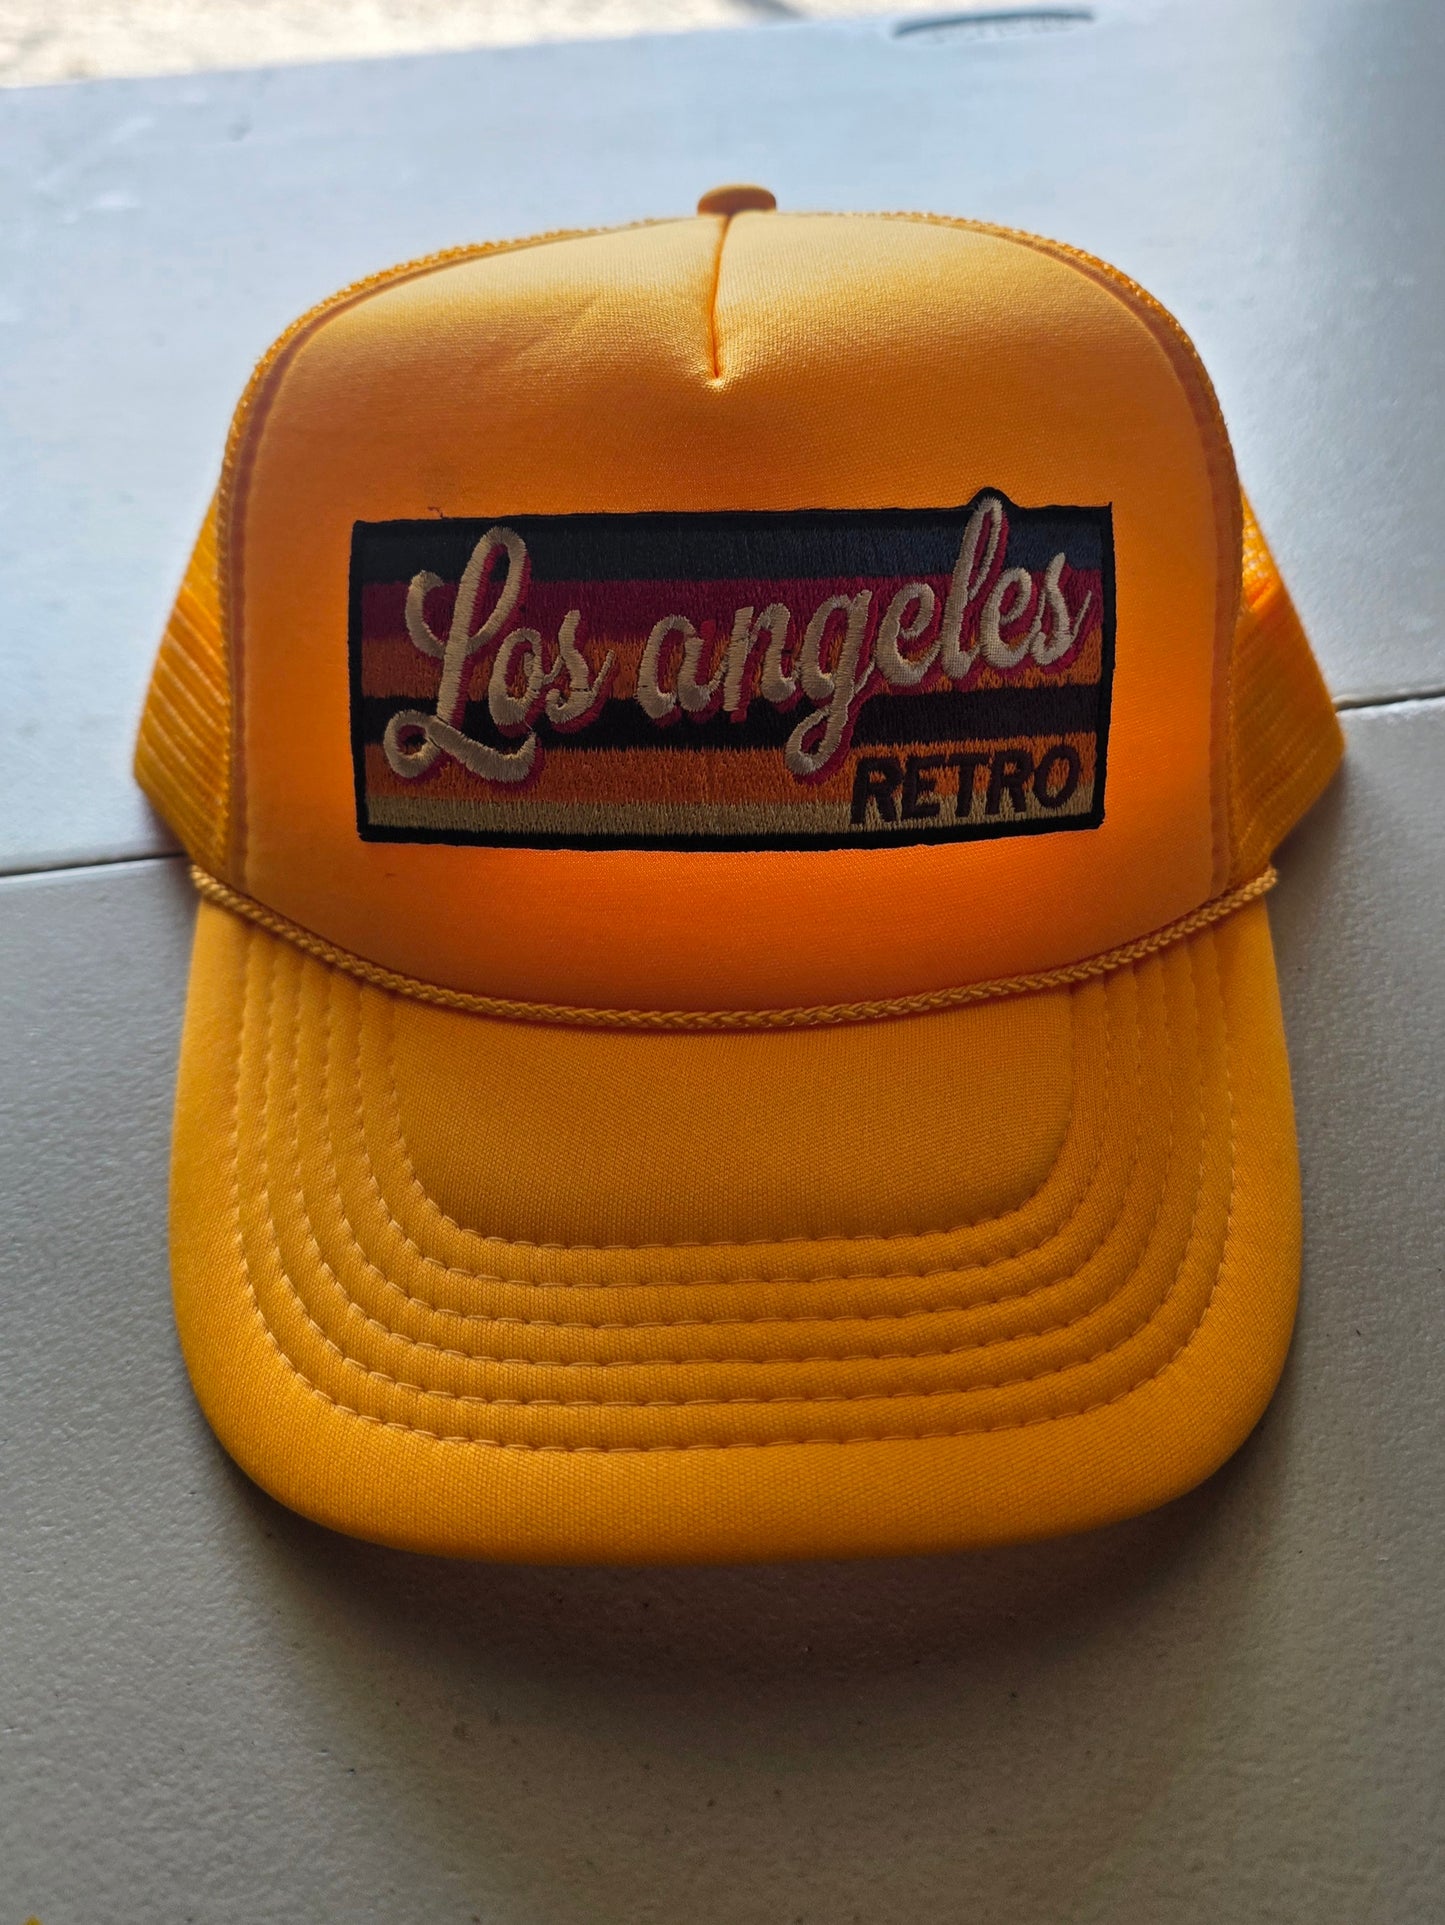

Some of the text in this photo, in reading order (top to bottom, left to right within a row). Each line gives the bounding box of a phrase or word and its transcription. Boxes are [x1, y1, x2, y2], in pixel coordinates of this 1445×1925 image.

[383, 497, 1092, 786] Los angeles
[850, 744, 1081, 825] RETRO
